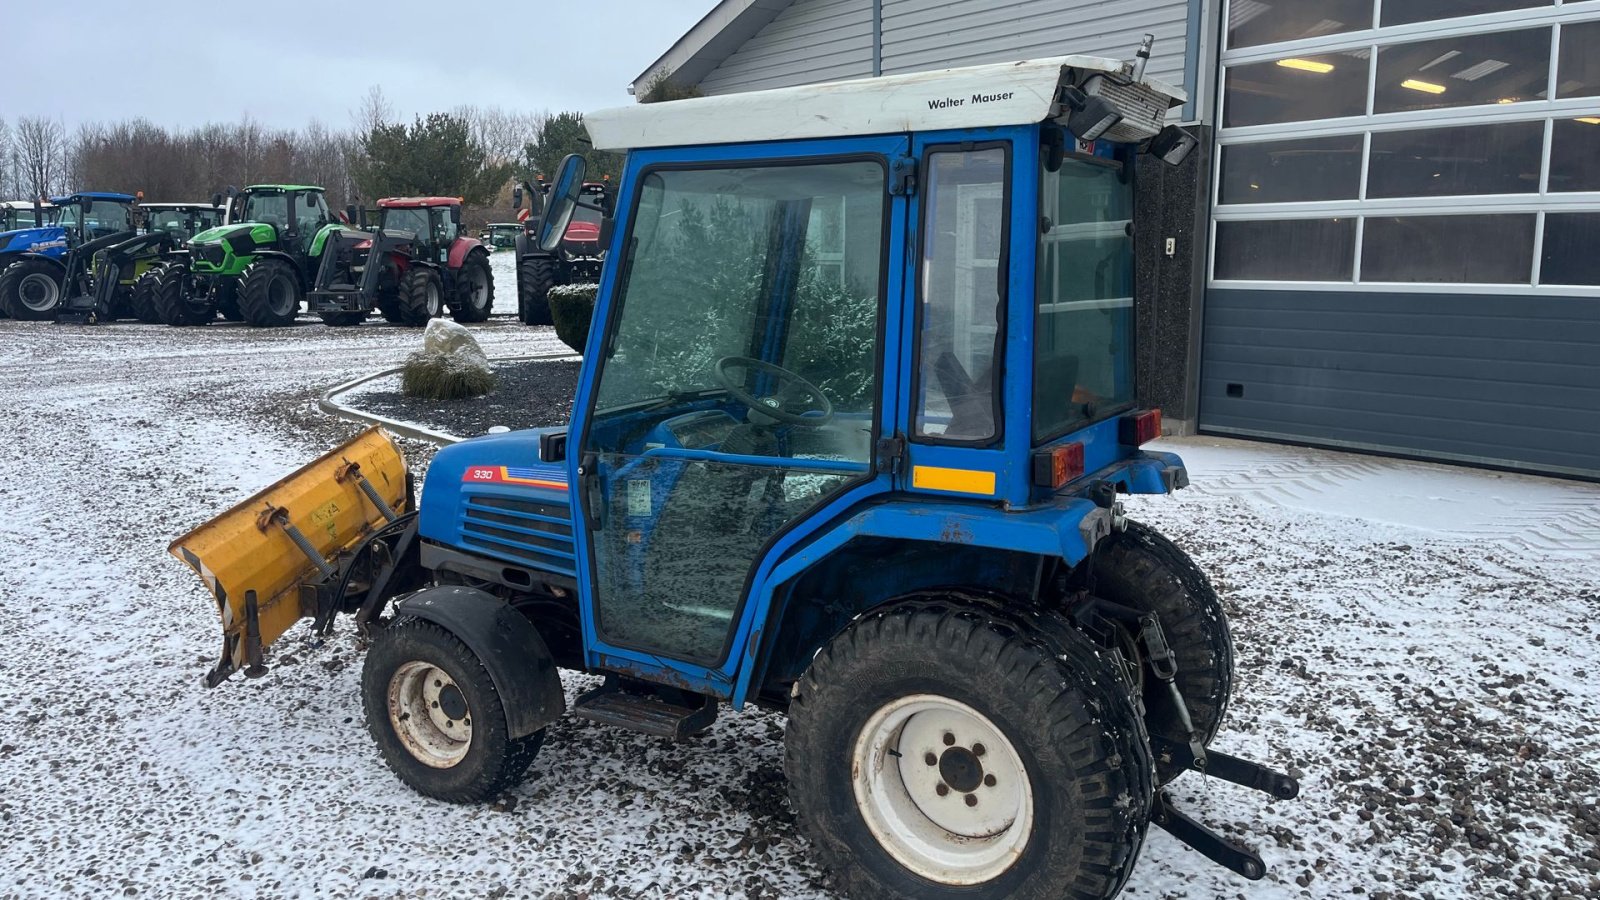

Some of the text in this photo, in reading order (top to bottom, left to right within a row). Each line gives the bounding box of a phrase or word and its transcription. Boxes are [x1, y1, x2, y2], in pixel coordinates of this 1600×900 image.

[928, 92, 1014, 110] Walter Mauser
[473, 469, 493, 479] 330
